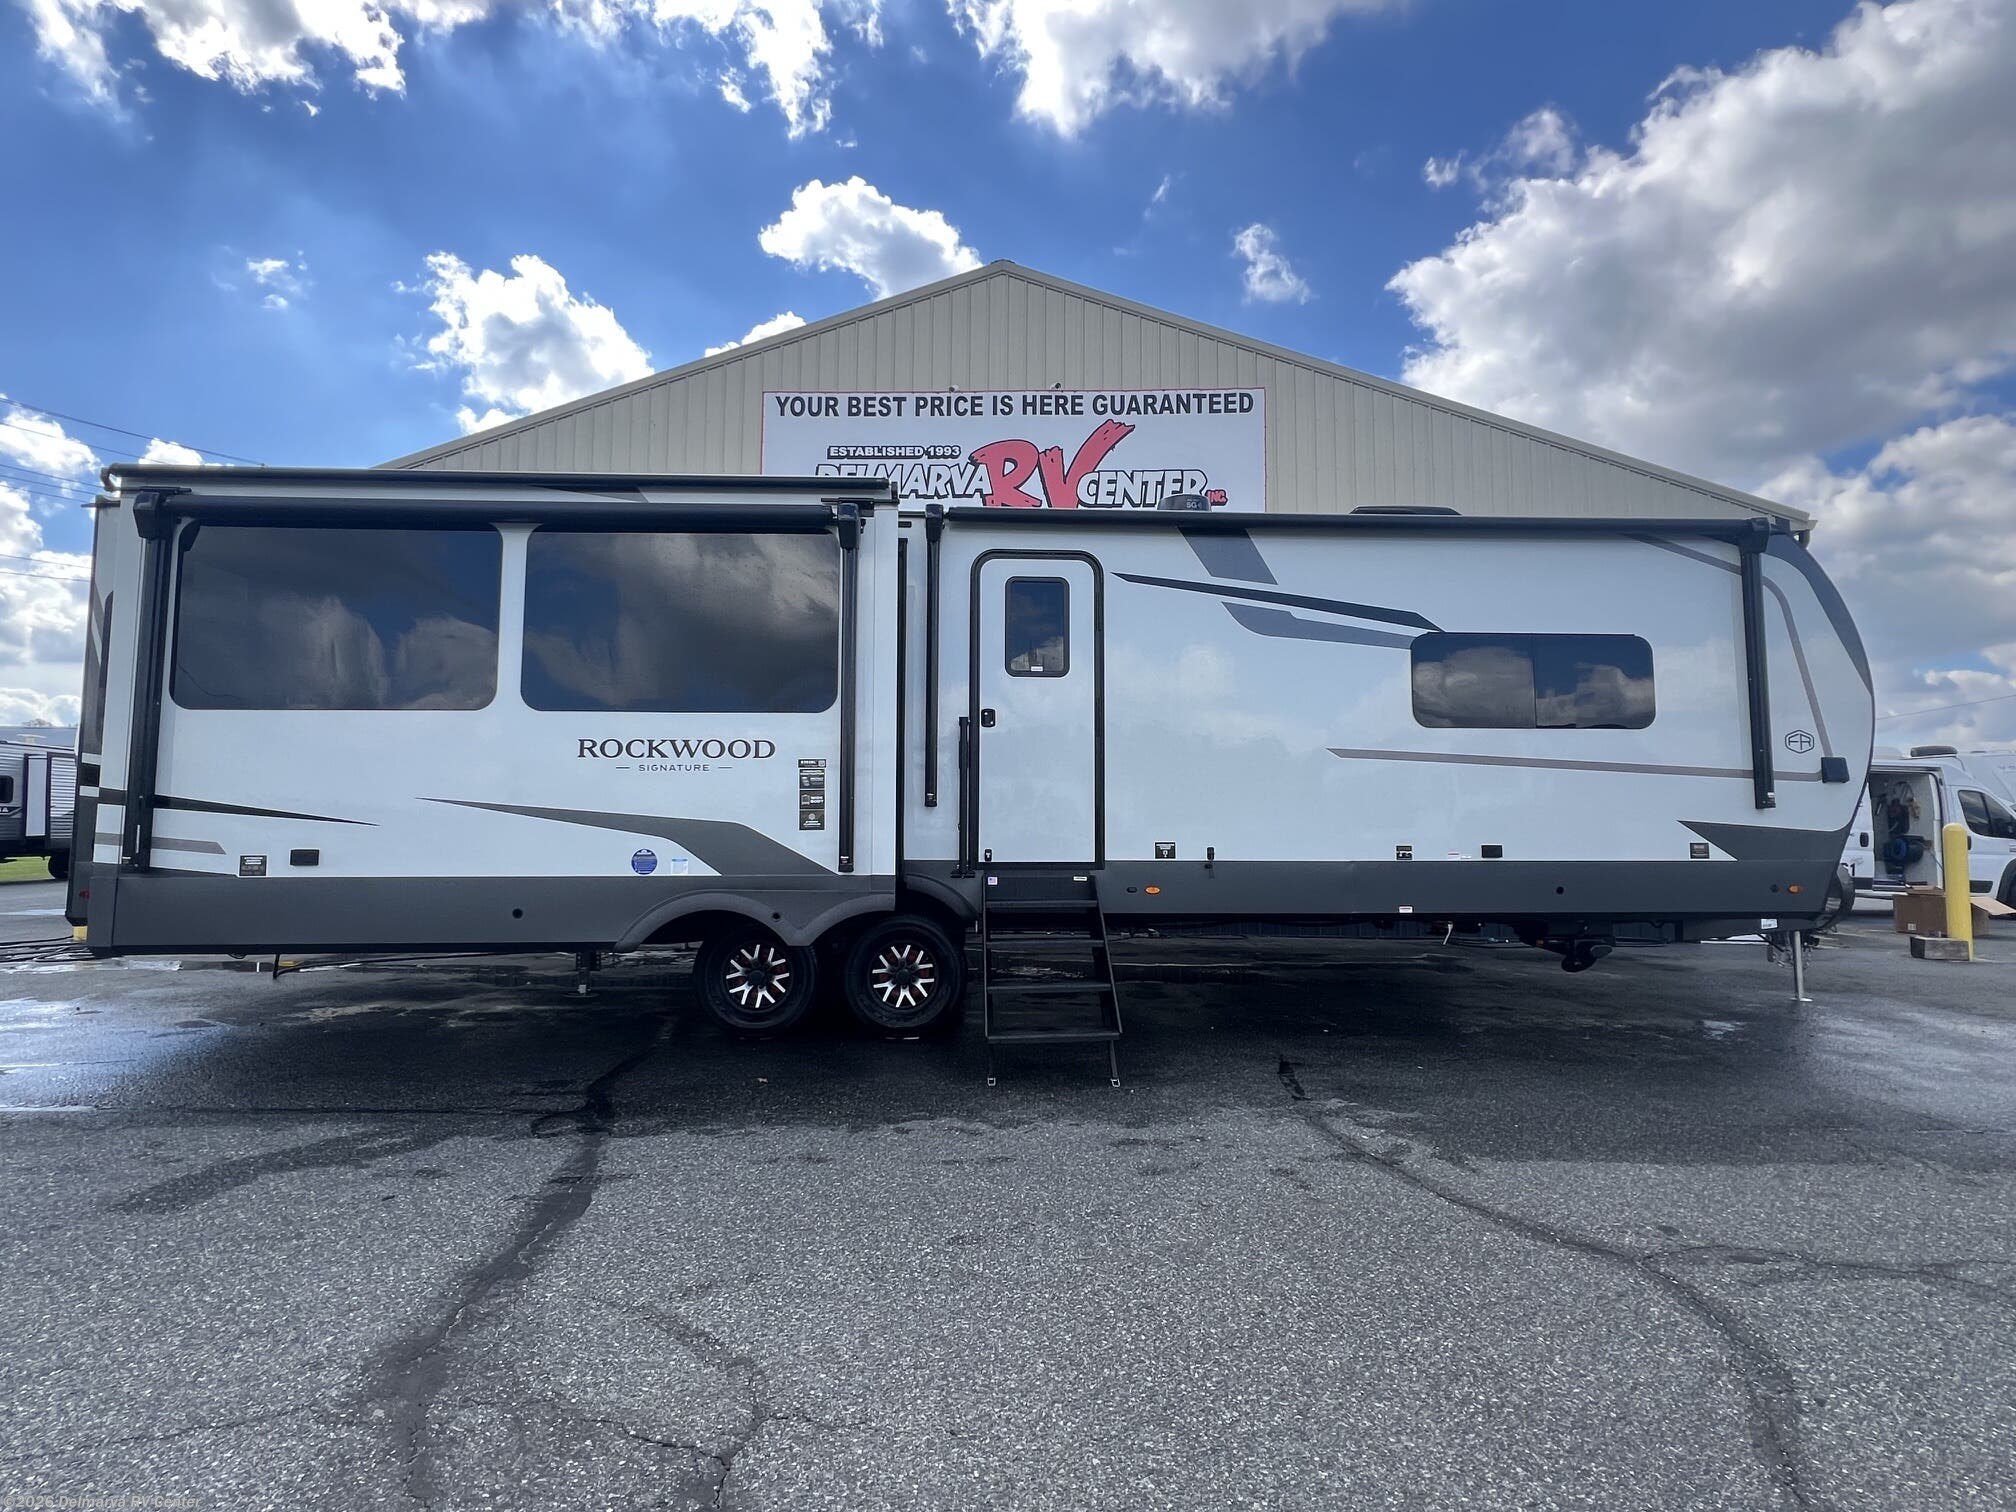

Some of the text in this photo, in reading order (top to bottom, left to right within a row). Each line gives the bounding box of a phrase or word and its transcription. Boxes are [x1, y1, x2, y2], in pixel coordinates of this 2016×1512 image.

[775, 393, 1254, 417] YOUR BEST PRICE IS HERE GUARANTEED
[828, 446, 961, 458] ESTABLISHED 1993
[968, 419, 1136, 508] RV
[1077, 470, 1208, 507] CENTER
[577, 739, 776, 759] ROCKWOOD
[638, 764, 711, 772] SIGNATURE
